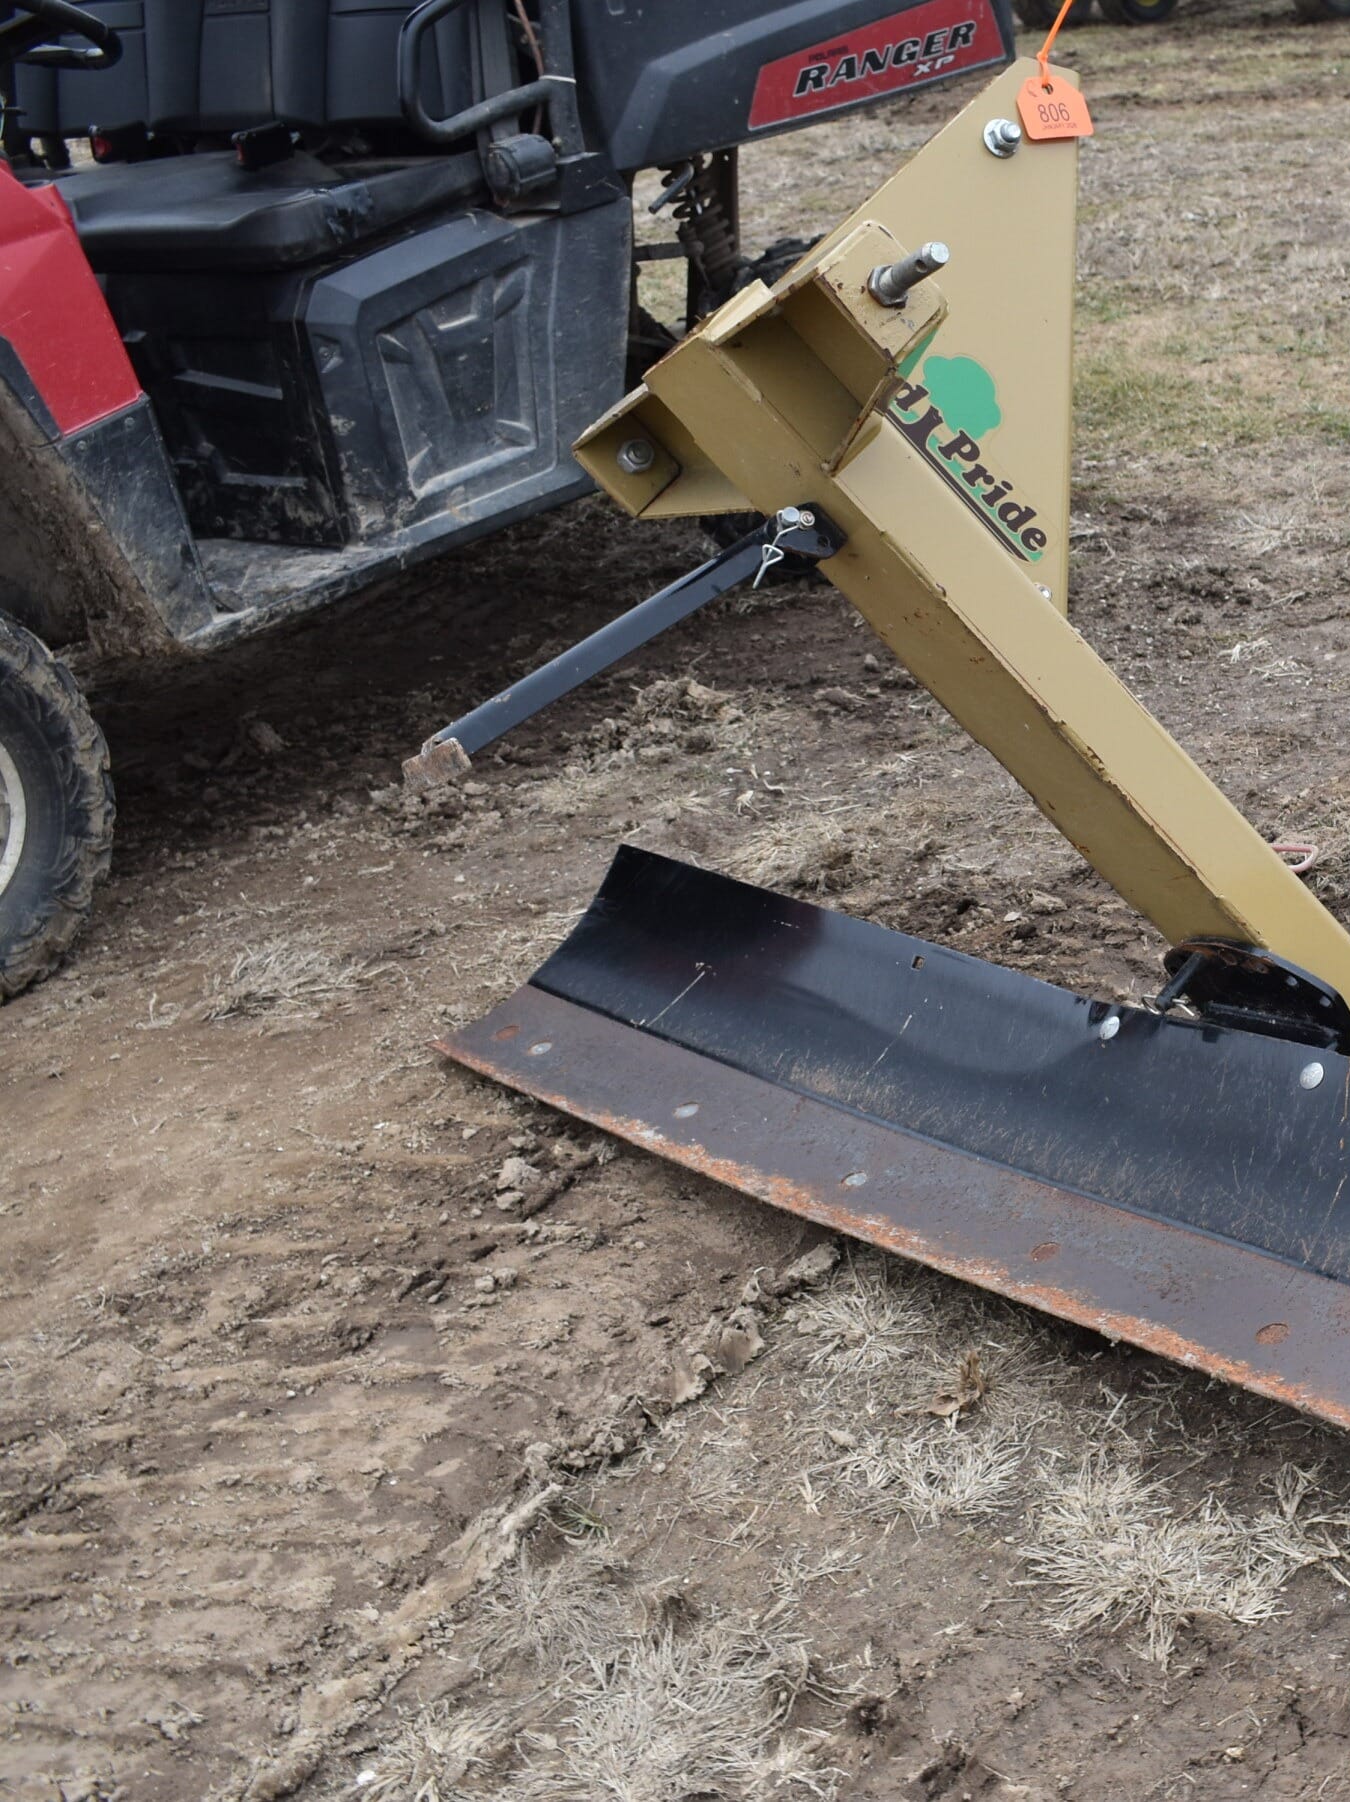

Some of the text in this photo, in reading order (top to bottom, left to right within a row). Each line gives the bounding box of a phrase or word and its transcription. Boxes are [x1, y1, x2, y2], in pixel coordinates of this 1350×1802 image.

[793, 21, 976, 97] RANGER
[913, 54, 955, 77] XP
[1037, 102, 1070, 123] 806
[938, 429, 1047, 551] Pride
